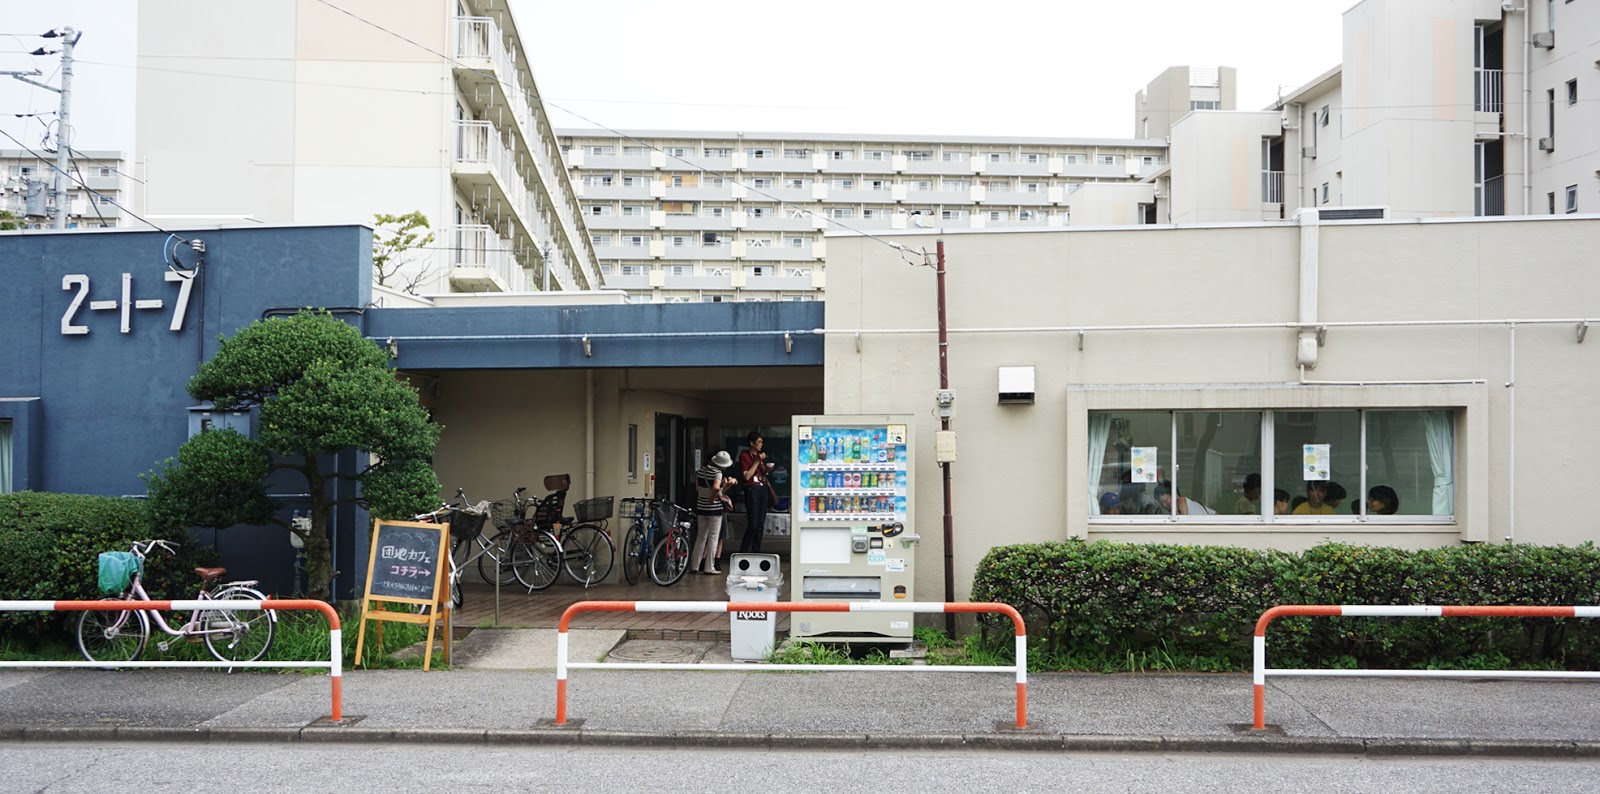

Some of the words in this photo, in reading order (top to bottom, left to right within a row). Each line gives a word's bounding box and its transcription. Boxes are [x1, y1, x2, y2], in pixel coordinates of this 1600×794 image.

[61, 271, 194, 334] 2-1-7
[381, 545, 431, 563] 団地カフェ
[390, 565, 418, 578] コチラ
